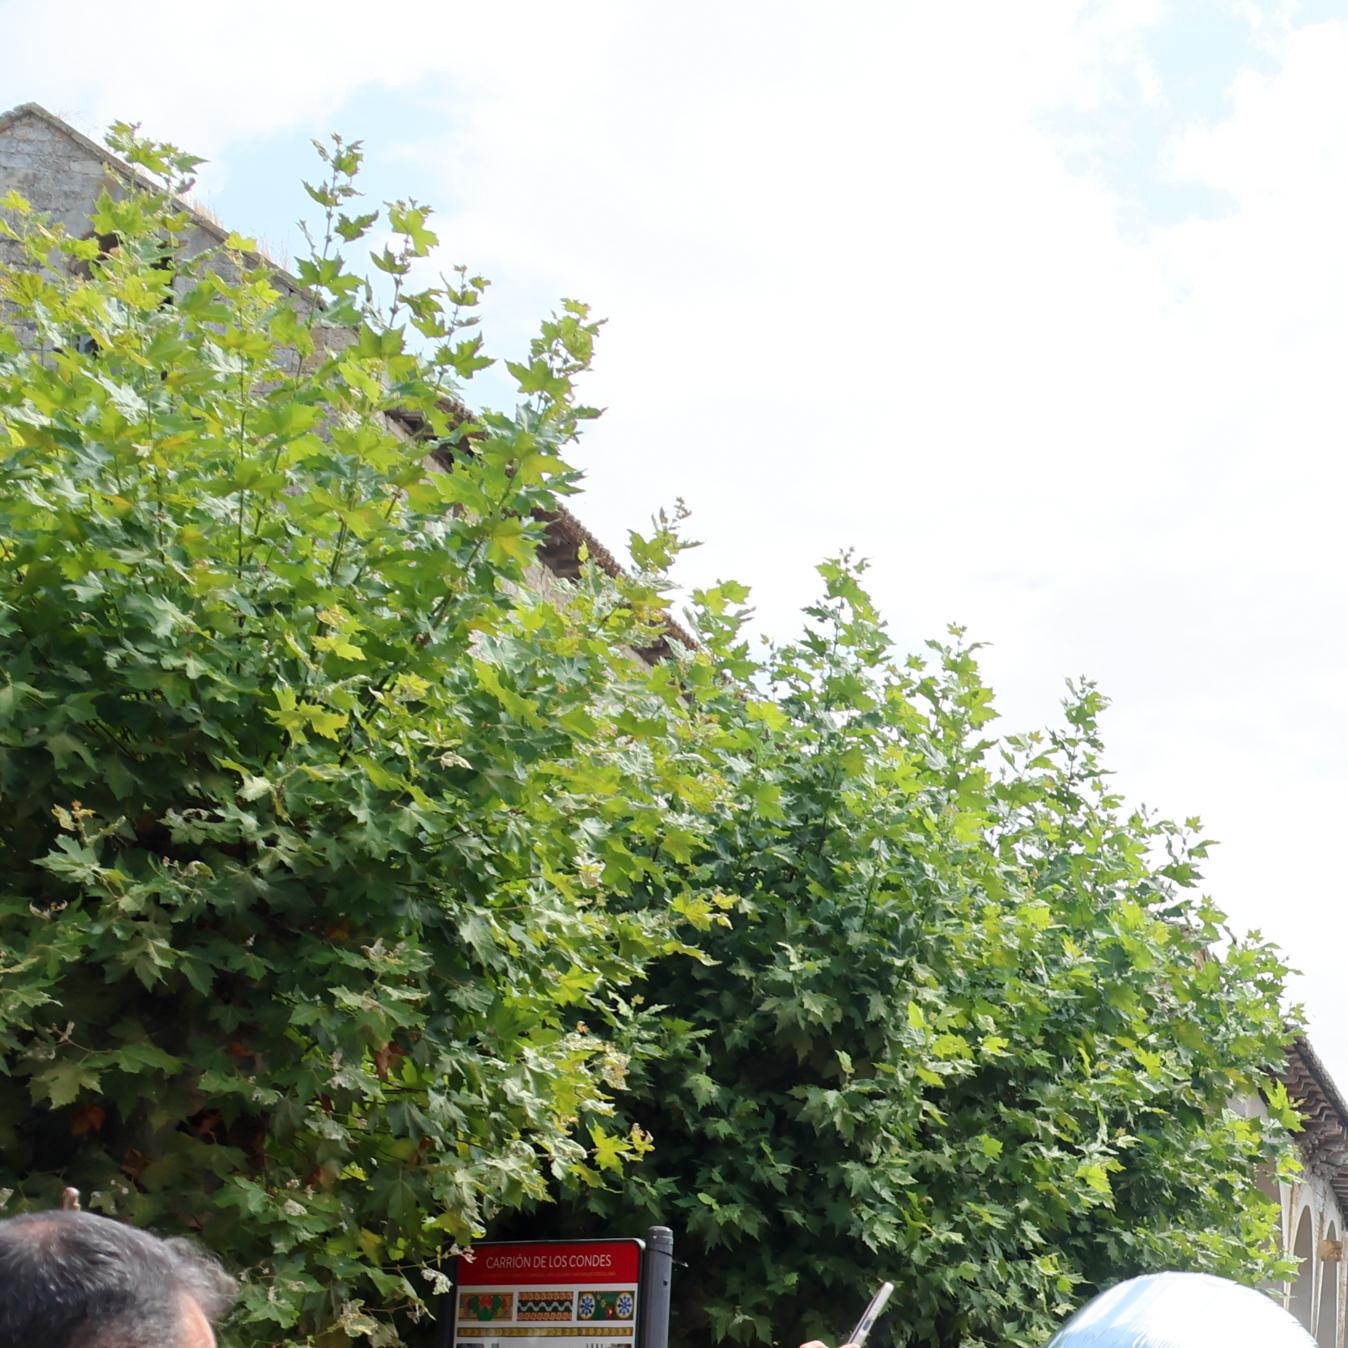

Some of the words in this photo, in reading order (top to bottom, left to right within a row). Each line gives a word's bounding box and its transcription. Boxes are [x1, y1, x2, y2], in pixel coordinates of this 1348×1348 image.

[486, 1255, 529, 1269] CARRIÓN
[533, 1255, 546, 1268] DE
[549, 1255, 567, 1268] LOS
[568, 1254, 612, 1268] CONDES
